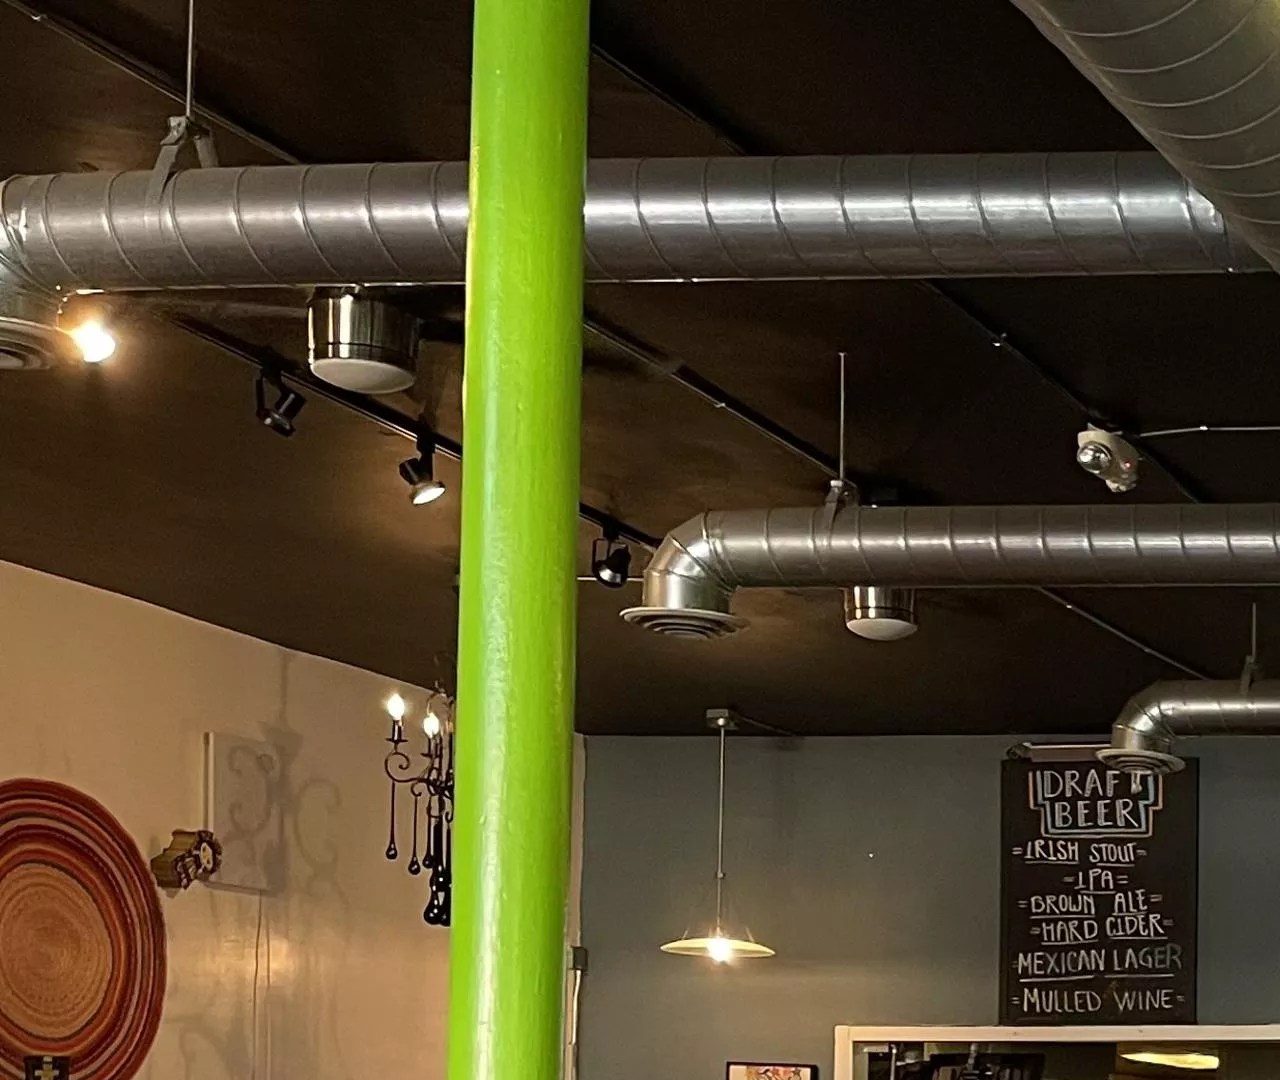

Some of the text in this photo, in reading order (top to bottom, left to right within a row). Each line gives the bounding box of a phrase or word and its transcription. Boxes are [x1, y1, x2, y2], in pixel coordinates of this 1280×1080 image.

[1054, 799, 1139, 828] BEER
[1024, 839, 1136, 863] IRISH STOUT
[1074, 868, 1114, 890] IPA
[1030, 889, 1148, 915] BROWN ALE
[1042, 914, 1164, 942] HARD CIDER
[1017, 943, 1182, 975] MEXICAN LAGER
[1023, 987, 1175, 1013] MULLED WINE
